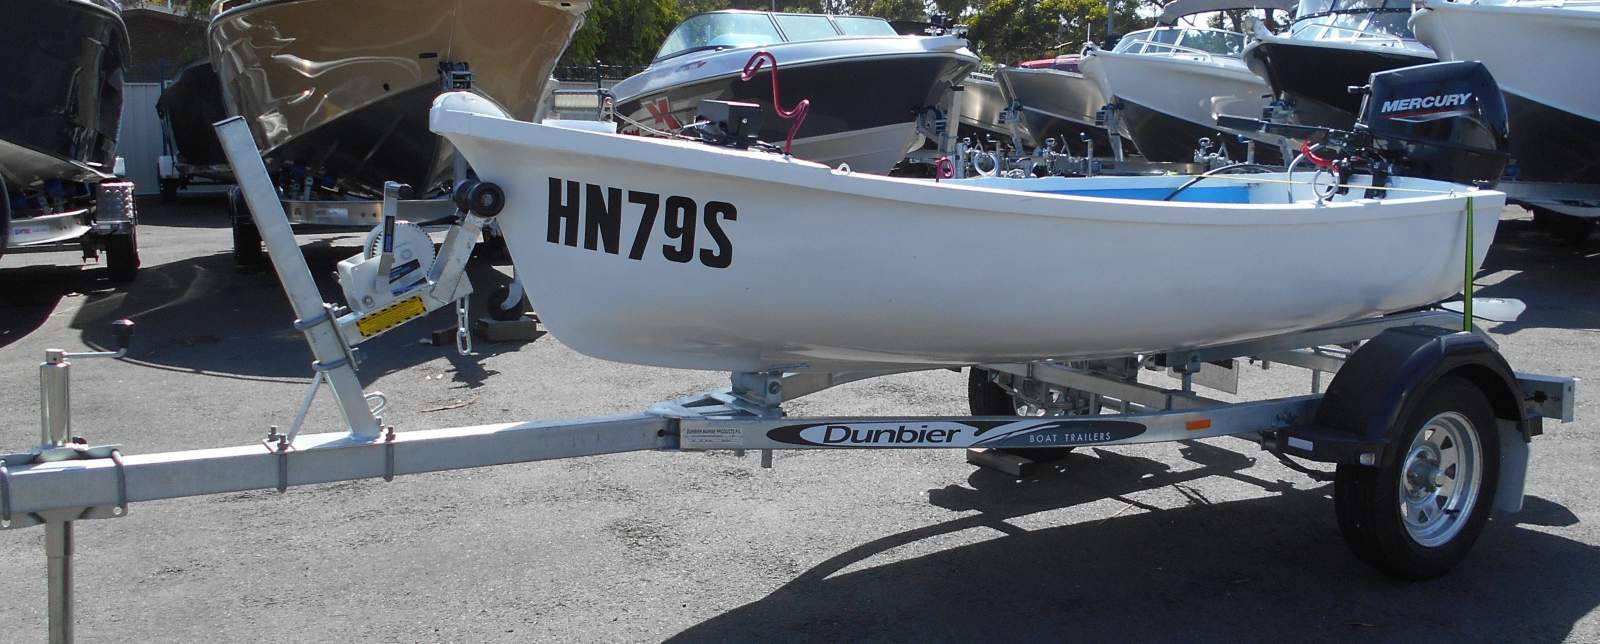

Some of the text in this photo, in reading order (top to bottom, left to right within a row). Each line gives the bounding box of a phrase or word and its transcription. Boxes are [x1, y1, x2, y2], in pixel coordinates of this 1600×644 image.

[1381, 93, 1473, 112] MERCURY
[547, 177, 738, 269] HN79S
[823, 425, 961, 443] Dunbier
[1029, 432, 1111, 443] BOAT TRAILERS
